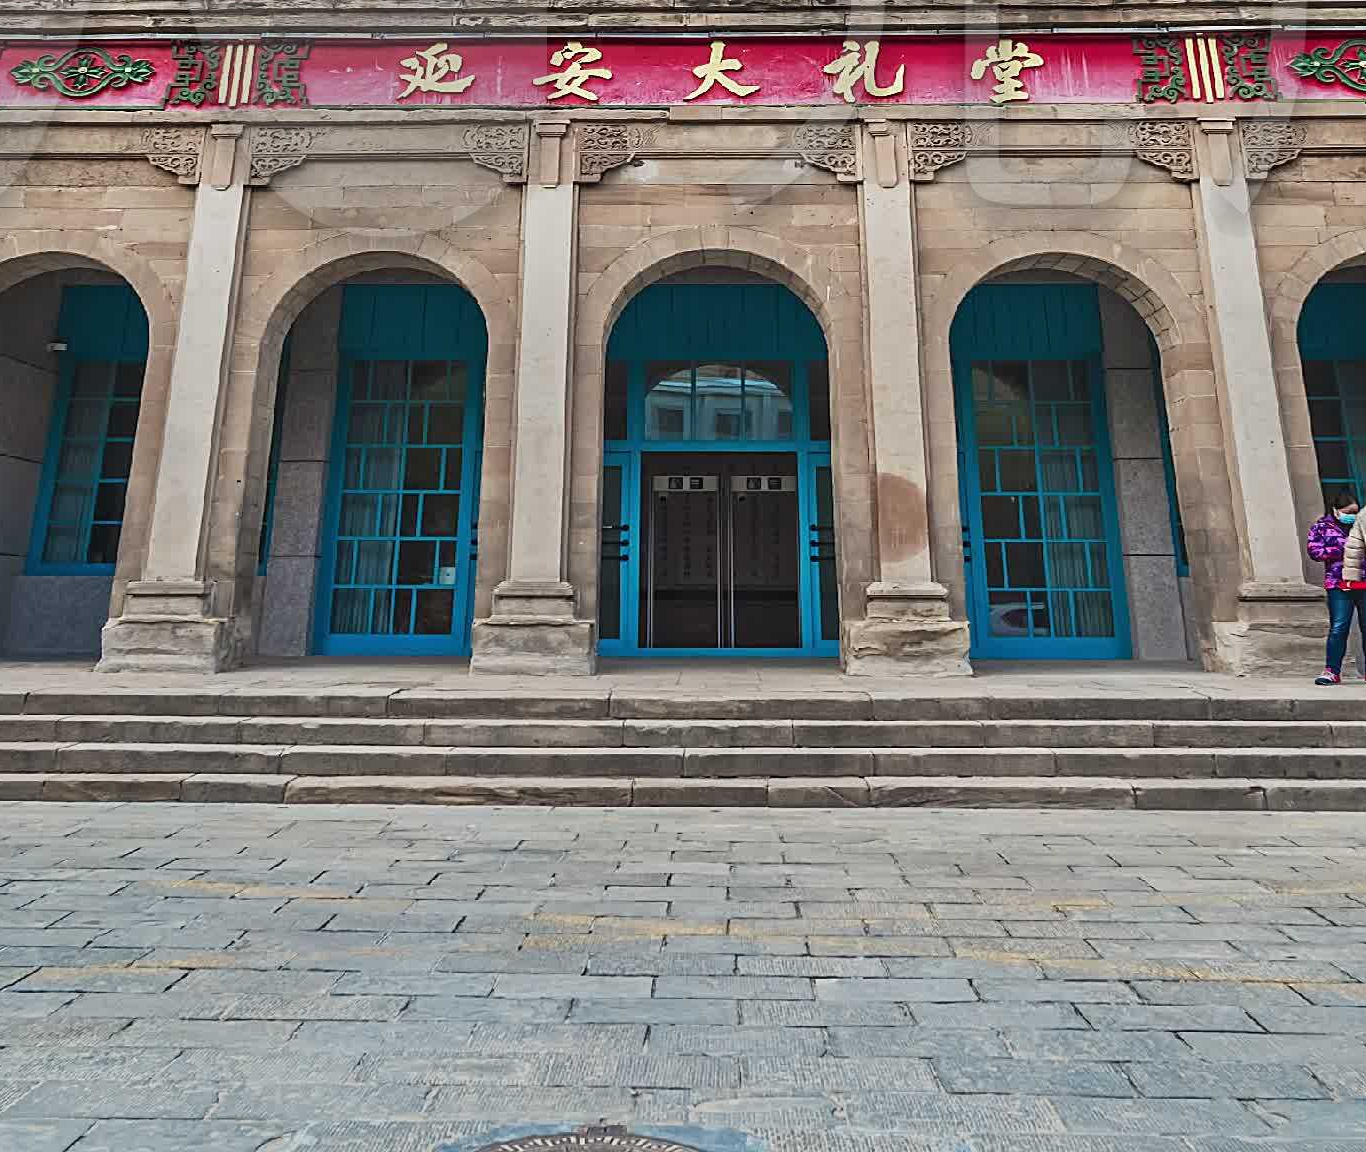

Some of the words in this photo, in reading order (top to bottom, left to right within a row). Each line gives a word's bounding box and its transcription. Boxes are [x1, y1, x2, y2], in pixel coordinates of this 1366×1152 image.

[398, 39, 1045, 104] 延安大礼堂
